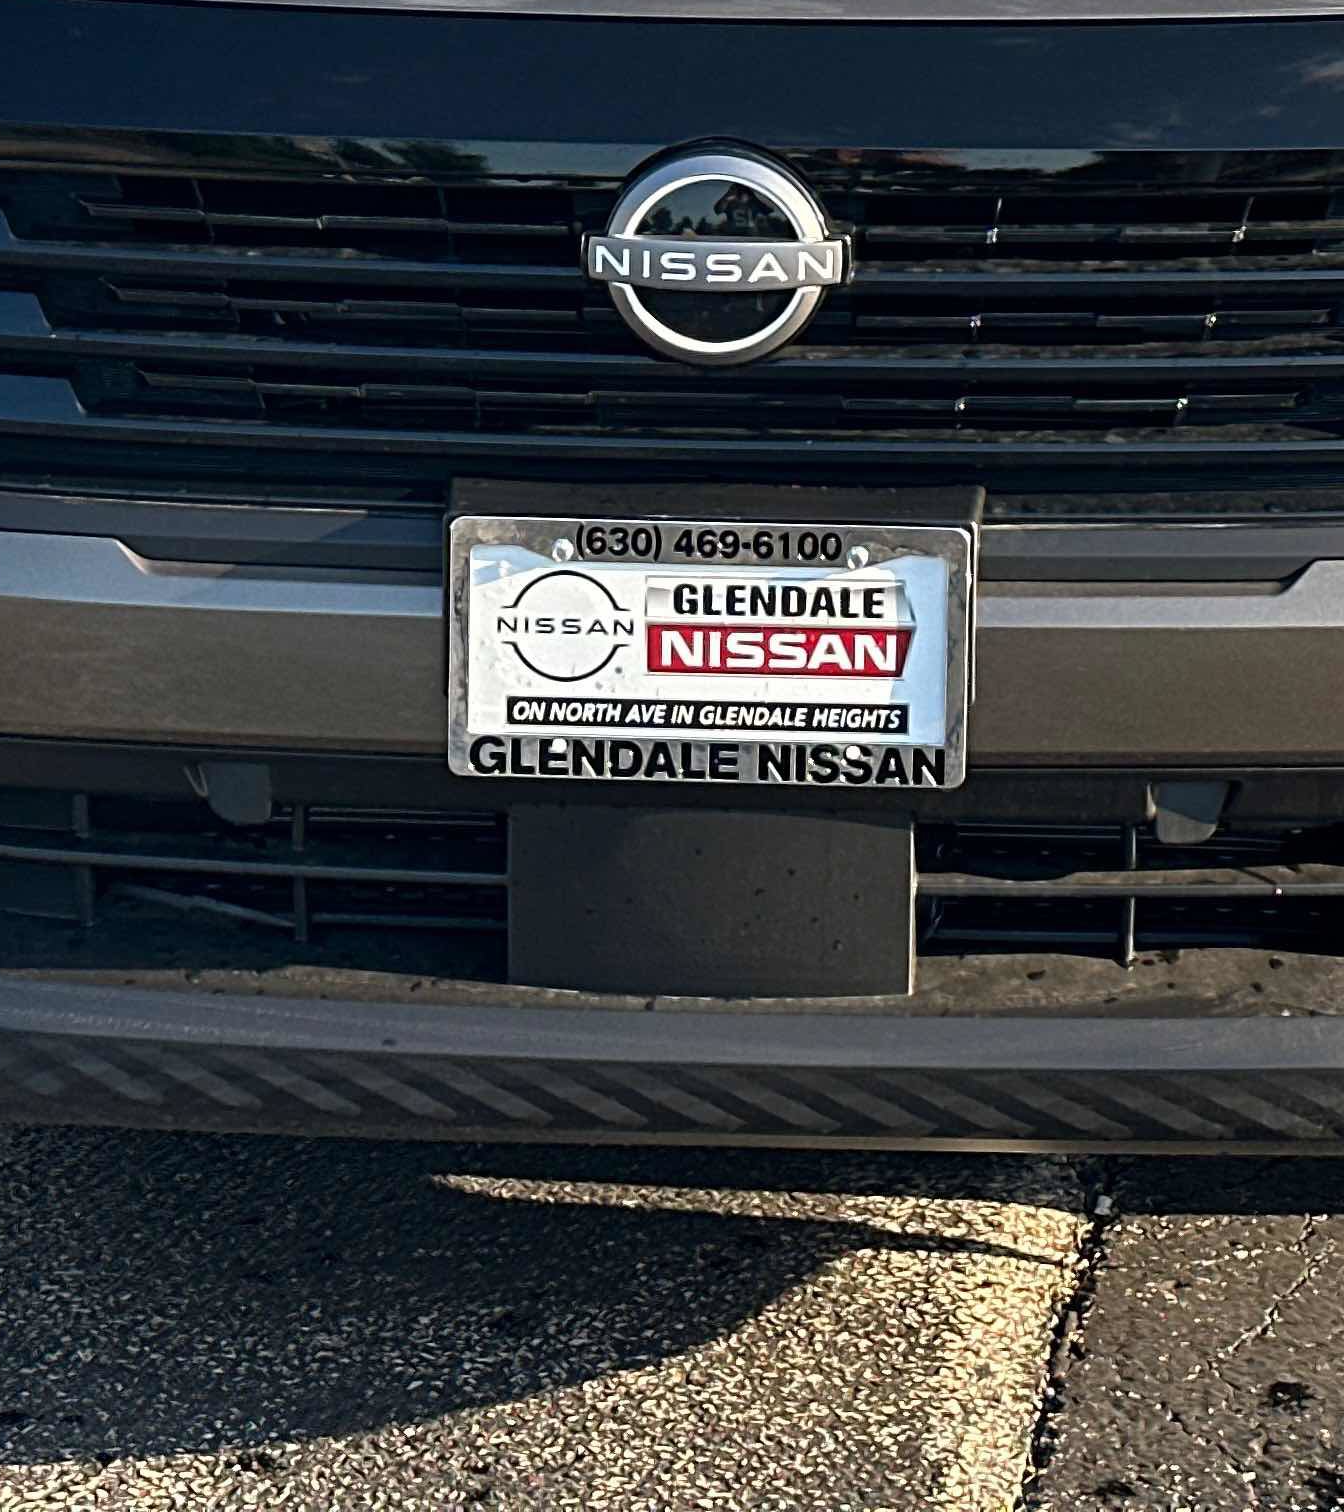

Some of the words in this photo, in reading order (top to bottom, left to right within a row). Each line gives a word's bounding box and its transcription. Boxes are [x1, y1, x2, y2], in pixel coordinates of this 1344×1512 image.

[595, 245, 834, 283] NISSAN
[574, 524, 662, 559] (630)
[674, 529, 843, 562] 469-6100
[673, 583, 885, 620] GLENDALE
[497, 617, 635, 637] NISSAN
[660, 629, 898, 672] NISSAN
[512, 701, 546, 722] ON
[549, 701, 622, 724] NORTH
[624, 703, 667, 725] AVE
[670, 705, 695, 725] IN
[698, 704, 808, 728] GLENDALE
[812, 707, 902, 730] HEIGHTS
[468, 735, 740, 779] GLENDALE
[757, 744, 946, 787] NISSAN
